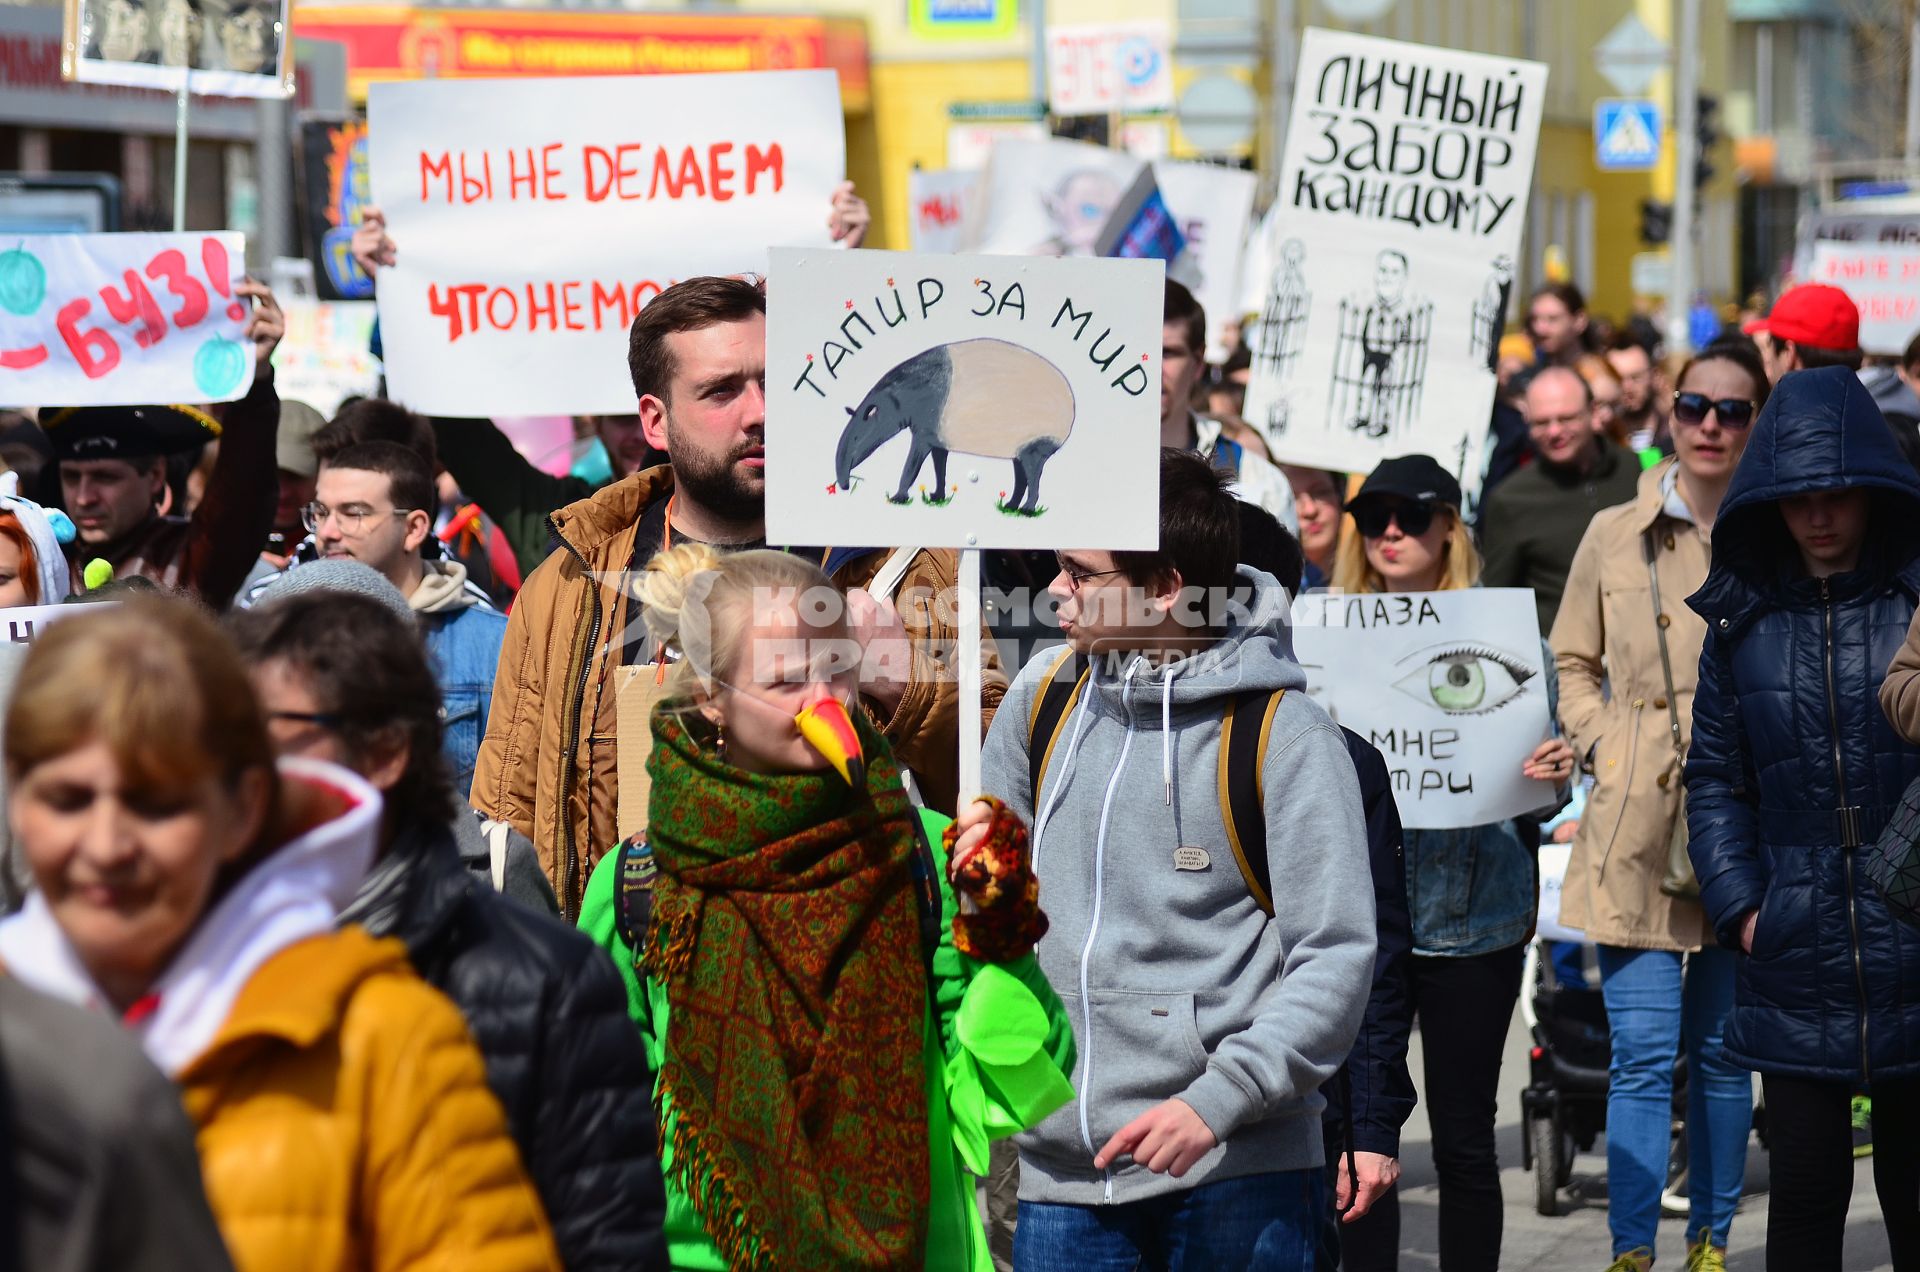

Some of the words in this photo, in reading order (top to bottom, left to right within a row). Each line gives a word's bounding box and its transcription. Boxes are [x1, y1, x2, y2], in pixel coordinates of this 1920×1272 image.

[1317, 55, 1524, 132] ЛИЧНЫЙ
[420, 149, 493, 204] МЫ
[508, 143, 567, 200] НЕ
[427, 280, 519, 343] ЧТО
[527, 281, 585, 332] НЕ
[794, 278, 945, 397] ТАПИР
[971, 280, 1026, 320] ЗА
[1051, 297, 1149, 396] МИР
[1321, 595, 1441, 629] ГЛАЗА
